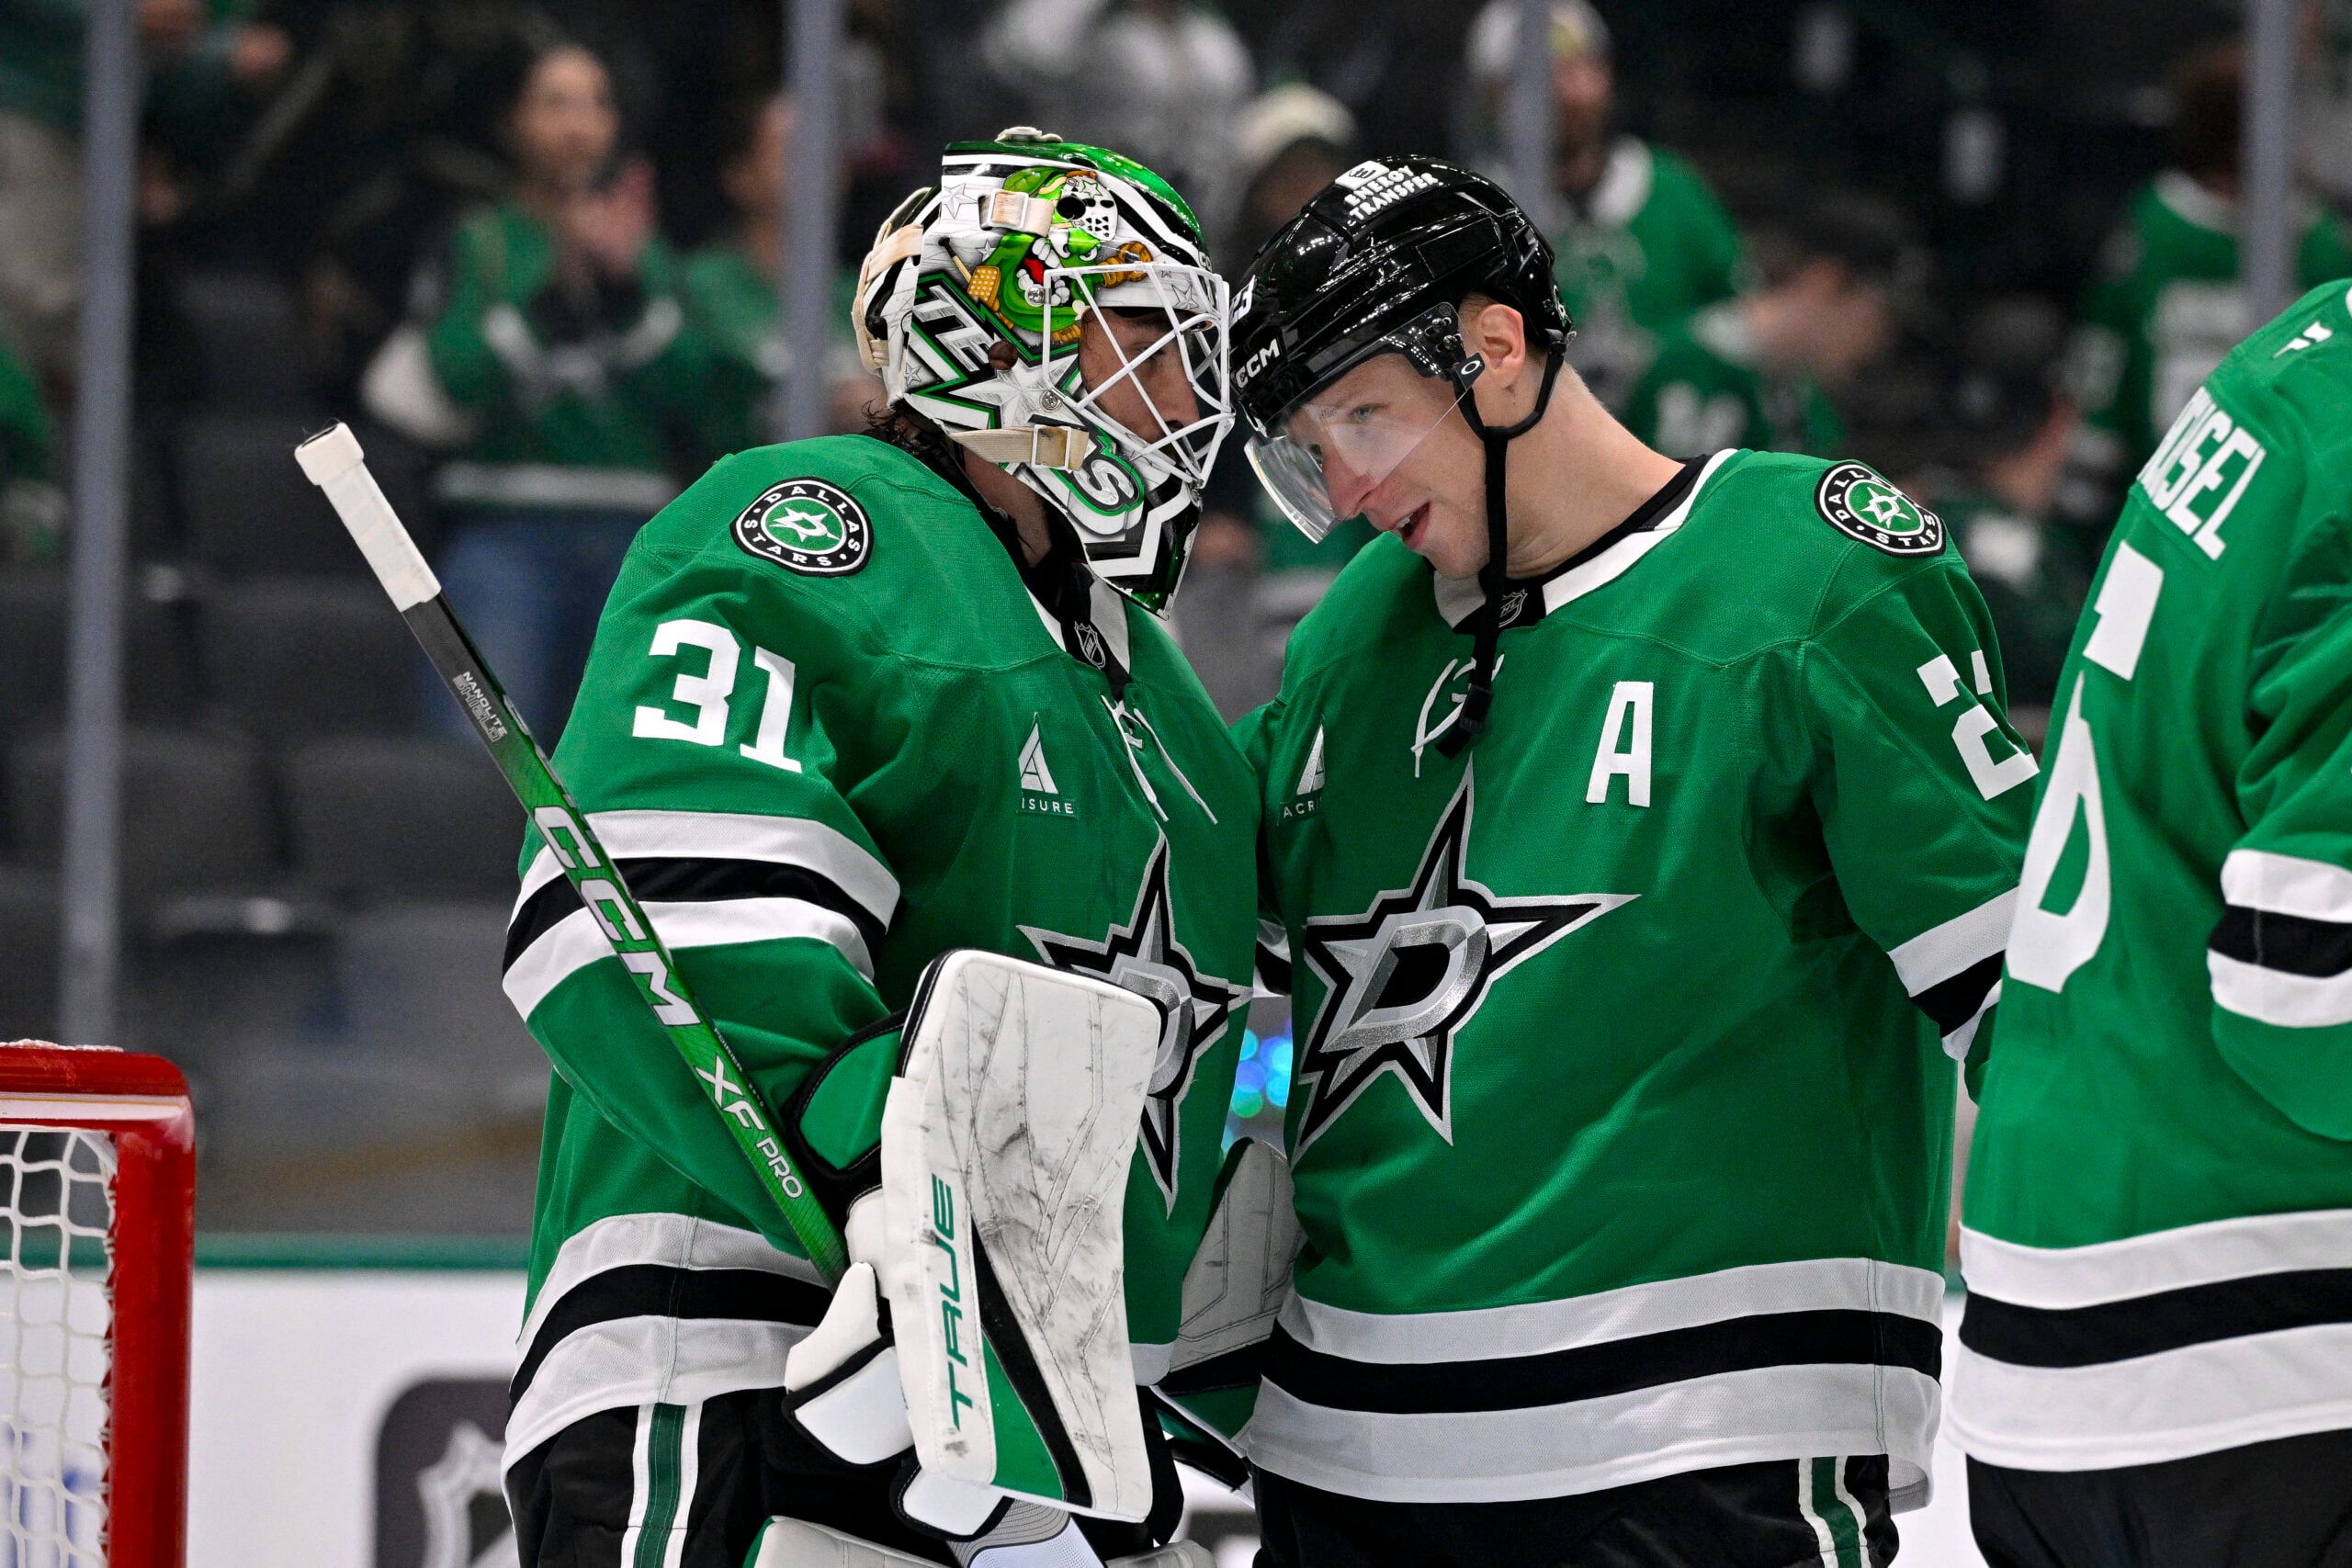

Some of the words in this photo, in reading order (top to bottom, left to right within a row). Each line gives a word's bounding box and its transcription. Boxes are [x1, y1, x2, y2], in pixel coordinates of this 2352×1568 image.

[1344, 165, 1414, 207] ENERGY
[1349, 172, 1439, 220] TRANSFER
[1235, 338, 1281, 389] CCM
[743, 519, 832, 567] STARS
[763, 486, 861, 552] DALLAS
[1875, 514, 1937, 547] STARS
[452, 674, 503, 742] SHIELD
[462, 671, 508, 737] NANOLITE
[632, 618, 802, 773] 31
[1586, 681, 1654, 807] A
[1022, 797, 1074, 814] ISURE
[1283, 798, 1319, 818] ACR
[534, 806, 701, 1026] CCM
[695, 1054, 765, 1132] XF
[756, 1136, 804, 1200] PRO
[932, 1172, 974, 1432] TRUE
